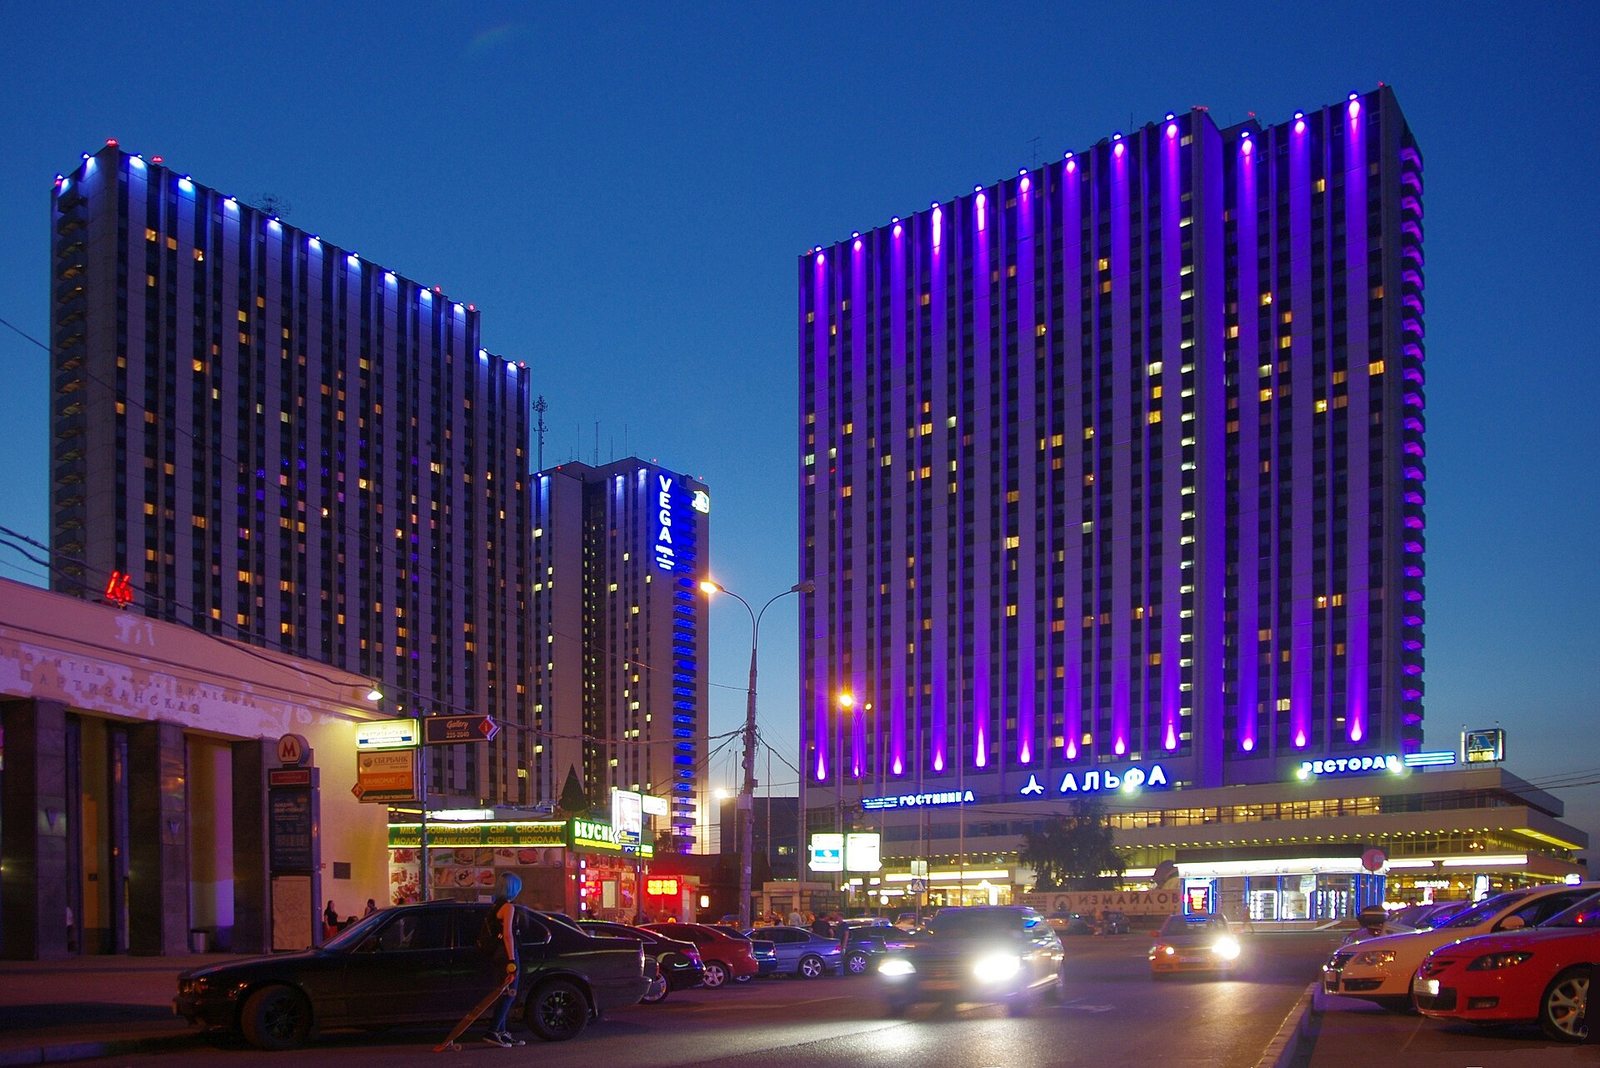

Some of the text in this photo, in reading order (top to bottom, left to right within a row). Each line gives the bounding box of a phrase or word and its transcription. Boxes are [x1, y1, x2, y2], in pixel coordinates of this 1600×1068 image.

[659, 475, 672, 544] VEGA
[21, 669, 201, 715] ПАРТИЗАНСКАЯ
[374, 756, 408, 764] СБЕРБАНК
[1060, 765, 1166, 793] АЛЬФА
[516, 825, 561, 833] CHOCOLATE
